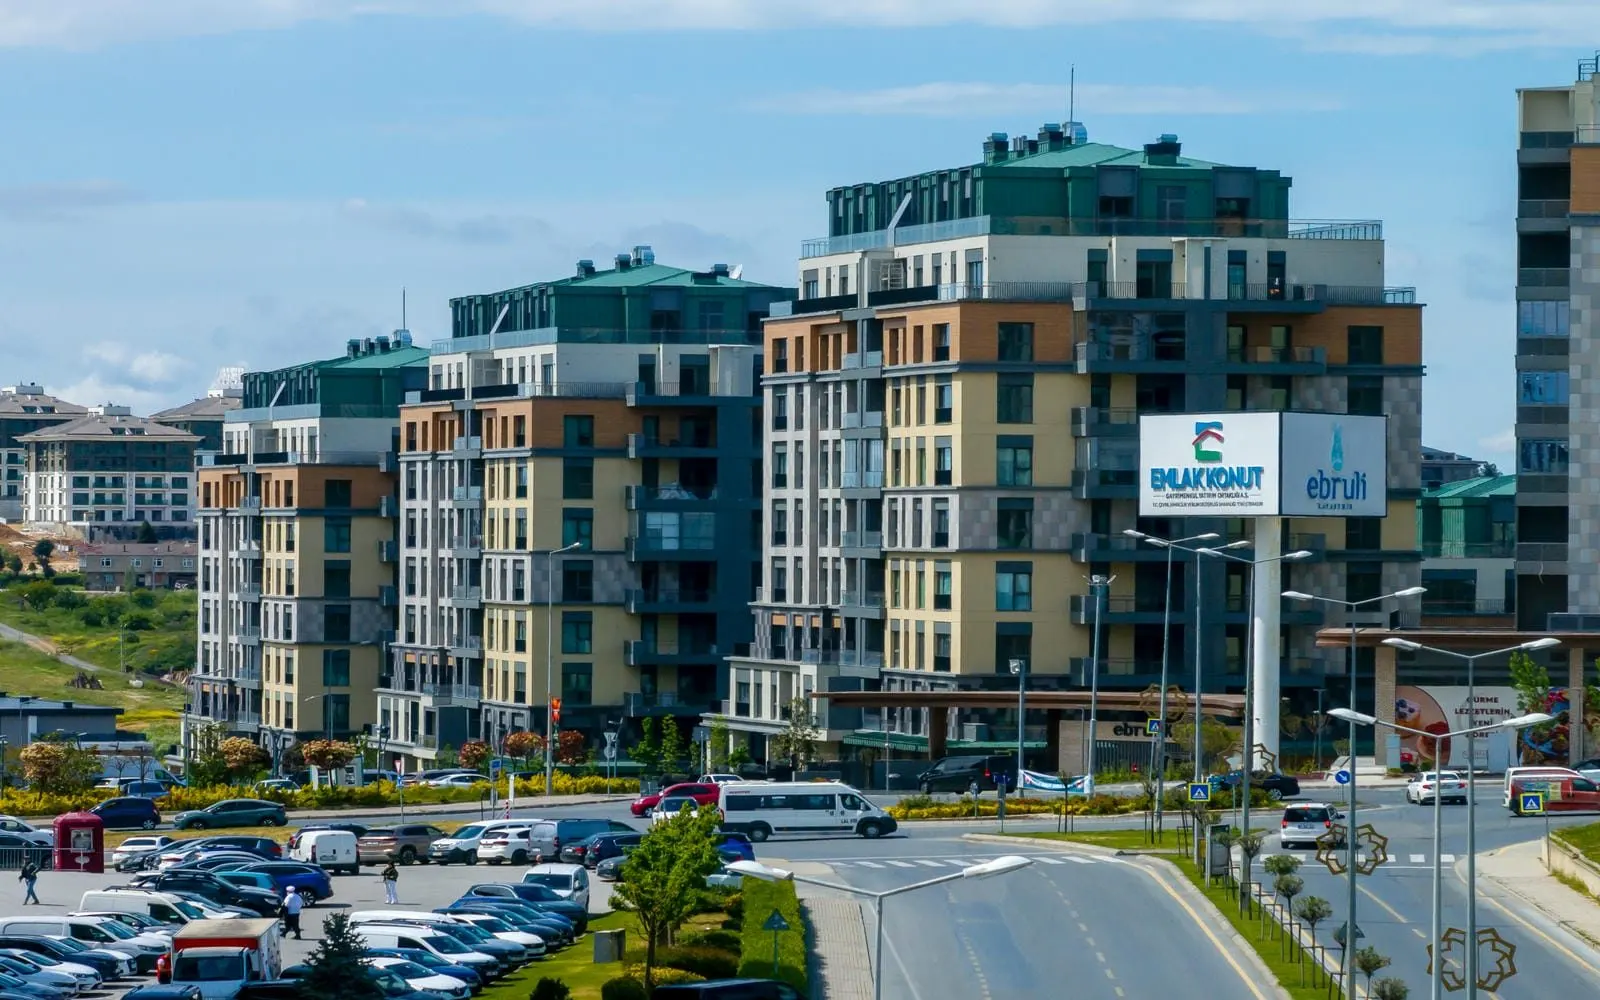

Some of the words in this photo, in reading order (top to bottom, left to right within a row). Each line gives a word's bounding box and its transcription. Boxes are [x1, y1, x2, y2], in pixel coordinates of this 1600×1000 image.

[1150, 467, 1205, 491] EMLAK
[1206, 466, 1264, 491] KONUT
[1307, 469, 1367, 500] ebruli
[1455, 707, 1510, 715] LEZETLERİN
